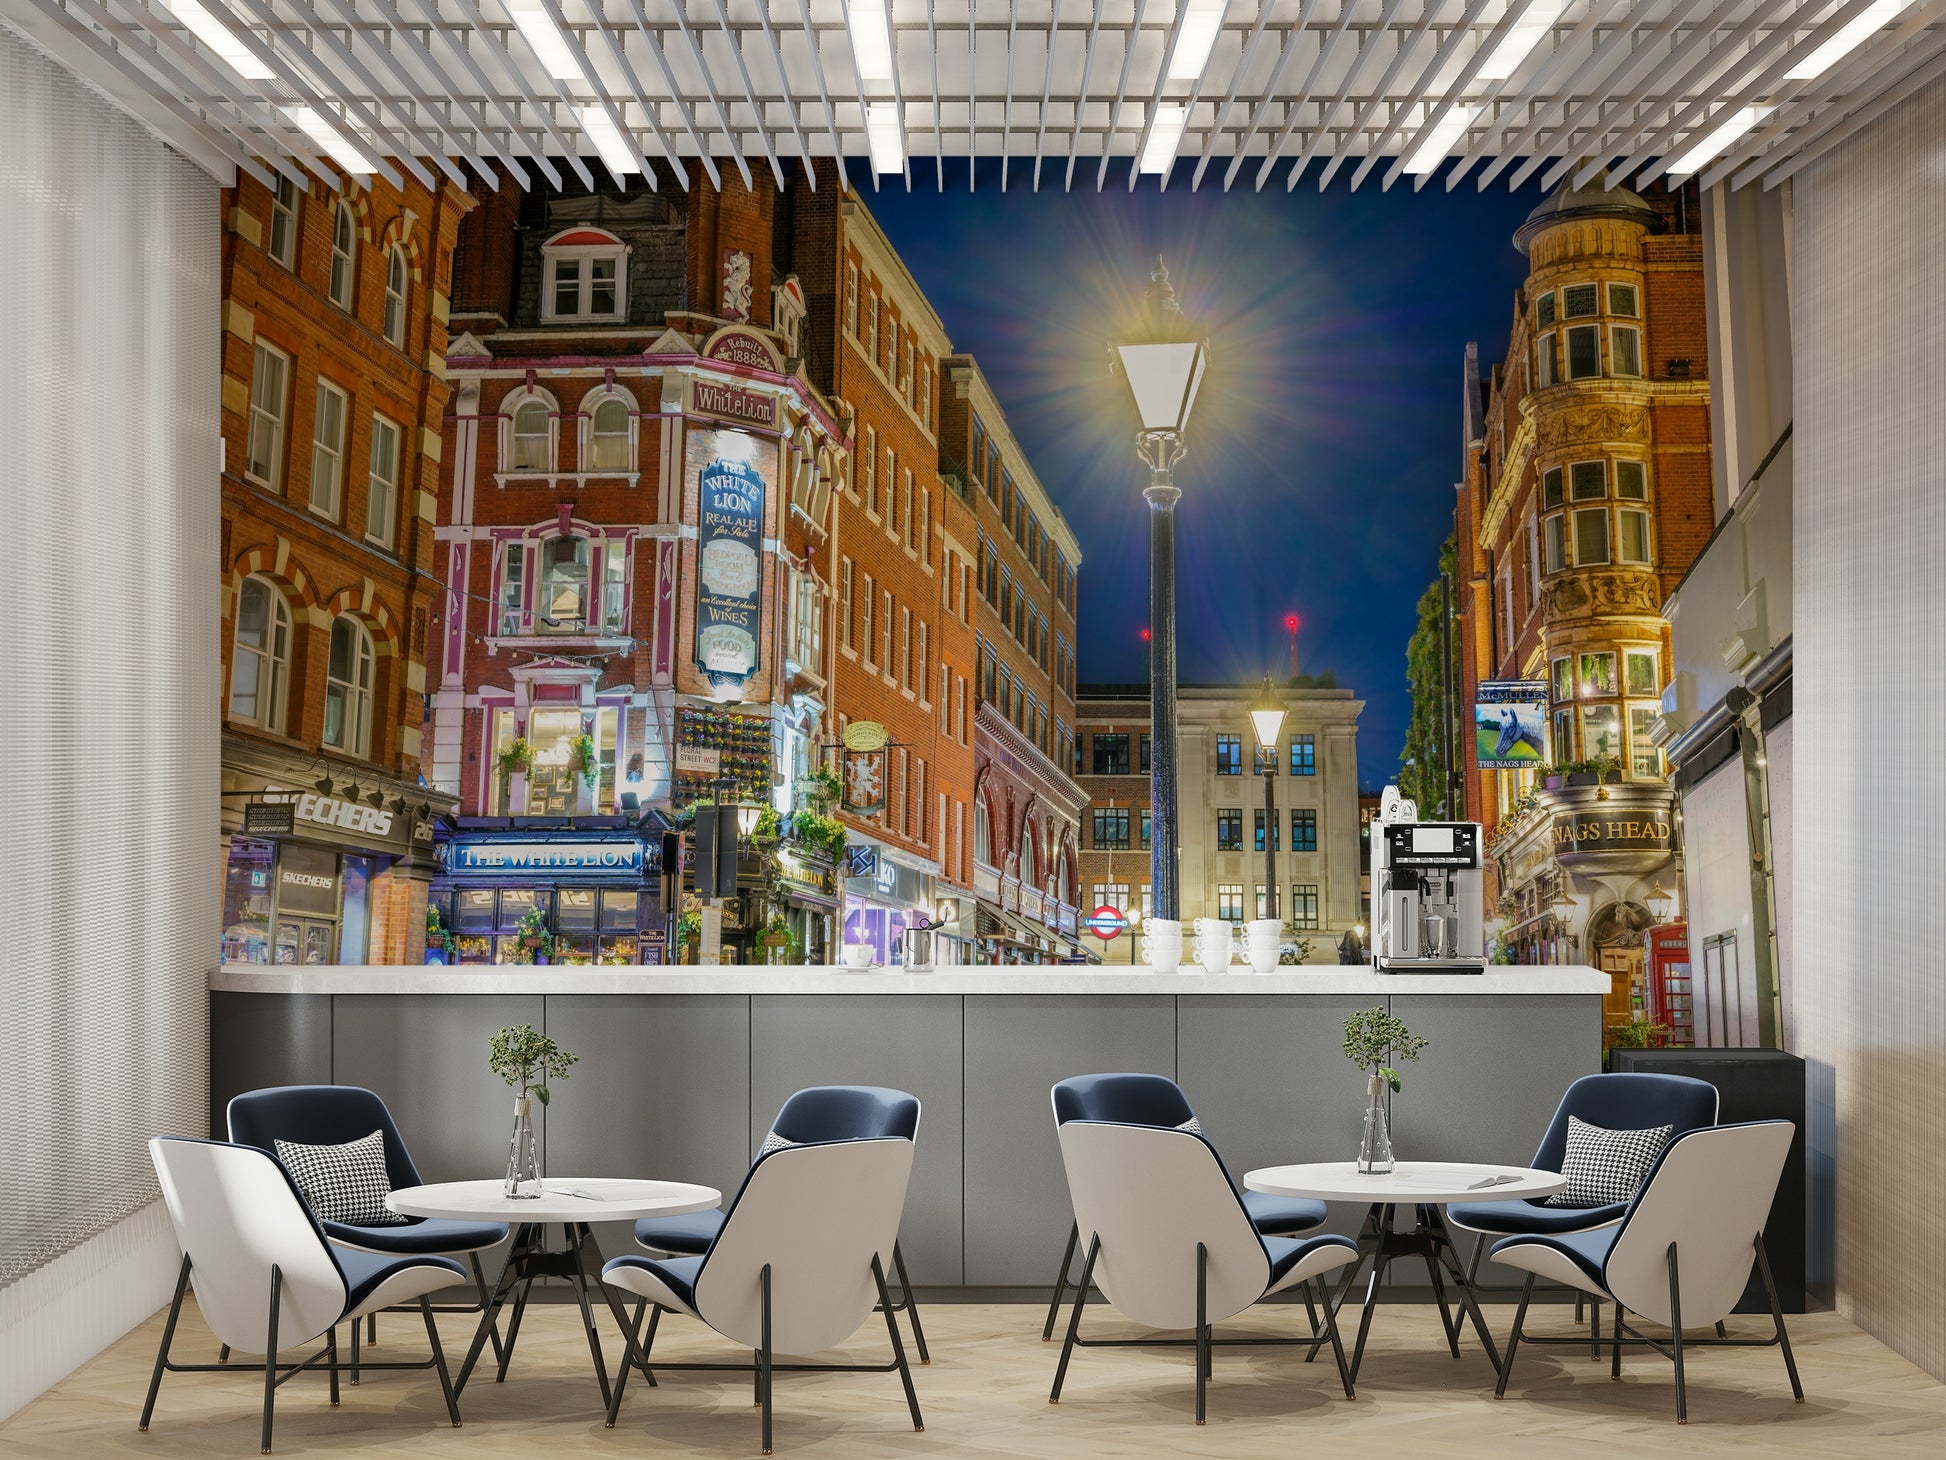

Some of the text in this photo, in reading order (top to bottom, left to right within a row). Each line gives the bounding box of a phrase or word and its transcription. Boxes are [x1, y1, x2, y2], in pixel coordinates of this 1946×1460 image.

[727, 339, 763, 355] Rebuilt
[733, 350, 757, 366] 1888
[721, 461, 746, 476] THE
[705, 475, 760, 501] WHITE
[714, 492, 752, 514] LION
[706, 511, 758, 532] REAL ALE
[708, 606, 749, 626] WINES
[713, 640, 742, 653] FOOD
[1478, 691, 1549, 700] McMULLEN
[679, 754, 717, 765] STREET WC2
[1478, 760, 1545, 768] THE NAGS HEAD
[414, 821, 434, 842] 26
[1554, 821, 1670, 843] NAGS HEAD
[461, 849, 636, 867] THE WHITE LION
[281, 872, 333, 888] SKECHERS
[1085, 919, 1128, 927] UNDERGROUND
